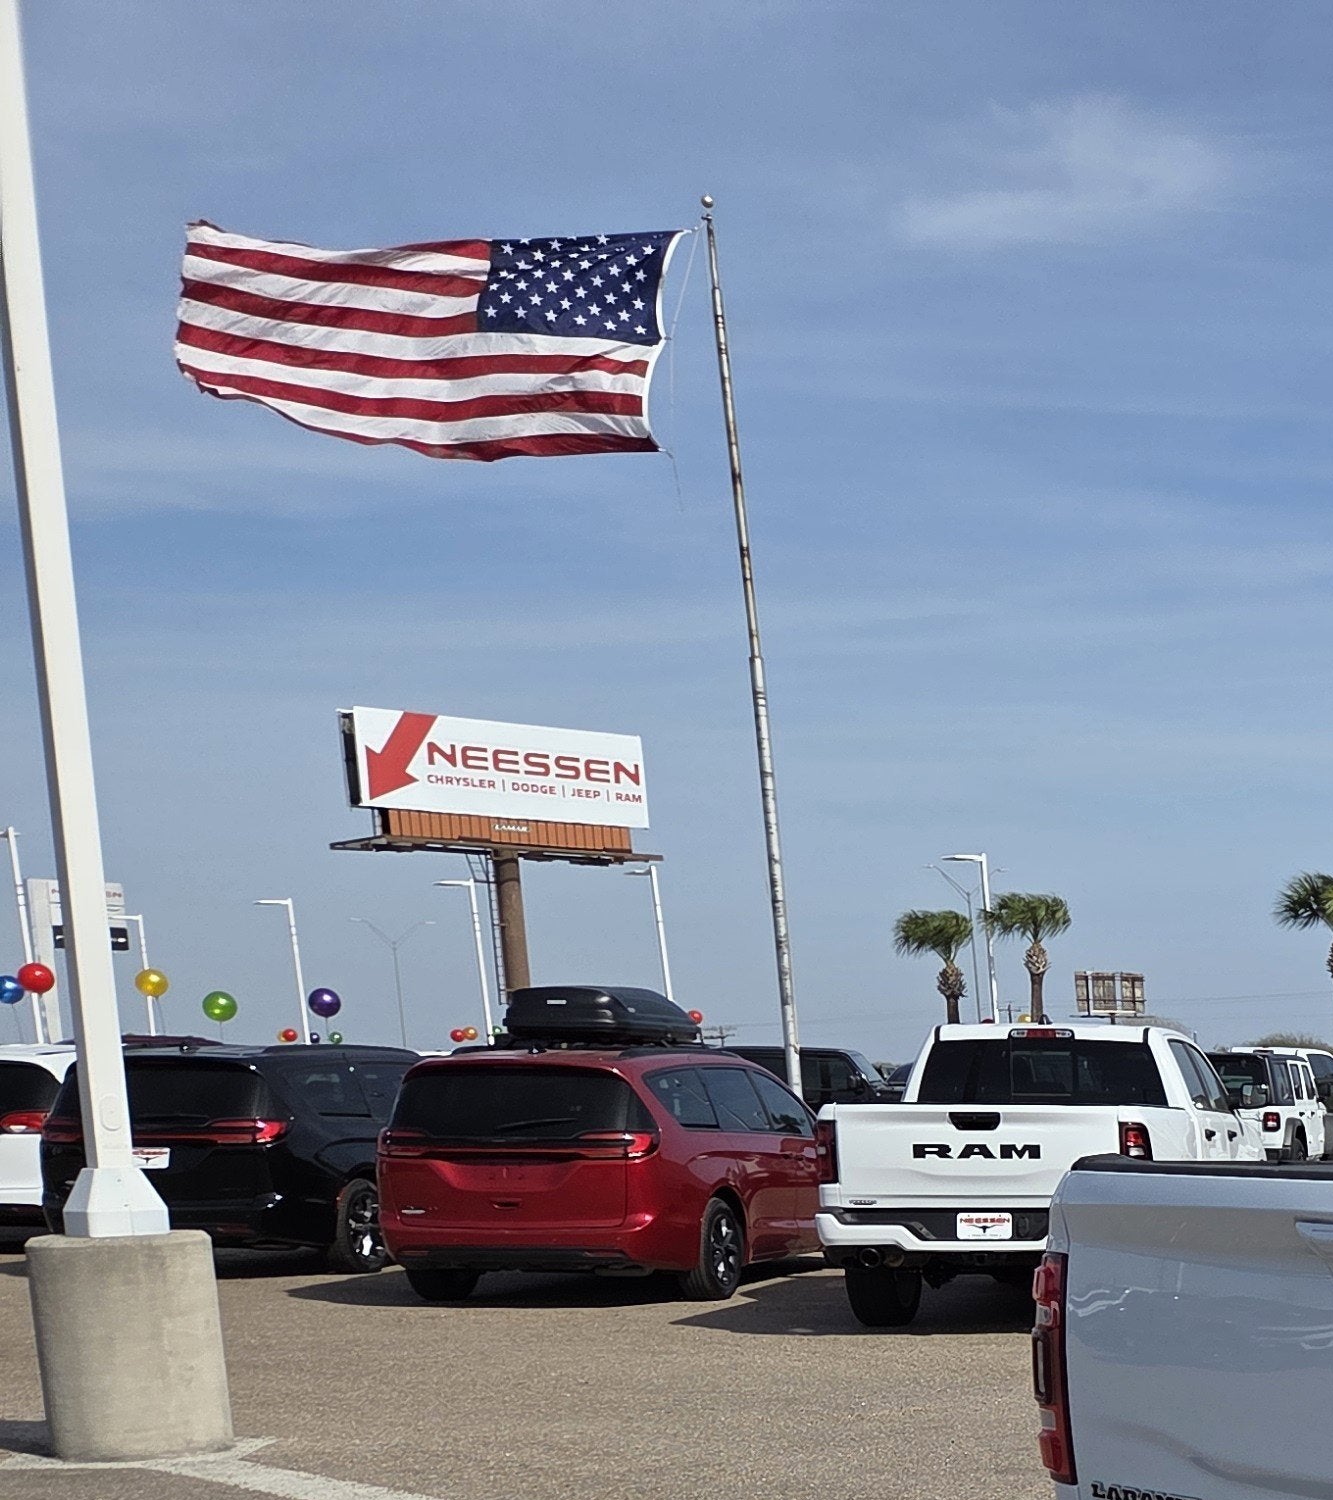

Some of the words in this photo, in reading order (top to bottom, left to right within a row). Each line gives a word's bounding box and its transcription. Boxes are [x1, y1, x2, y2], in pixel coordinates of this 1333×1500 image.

[427, 741, 641, 787] NEESSEN
[427, 774, 496, 789] CHRYSLER
[511, 782, 557, 796] DODGE
[570, 788, 601, 799] JEEP
[615, 792, 643, 804] RAM
[912, 1143, 1042, 1160] RAM
